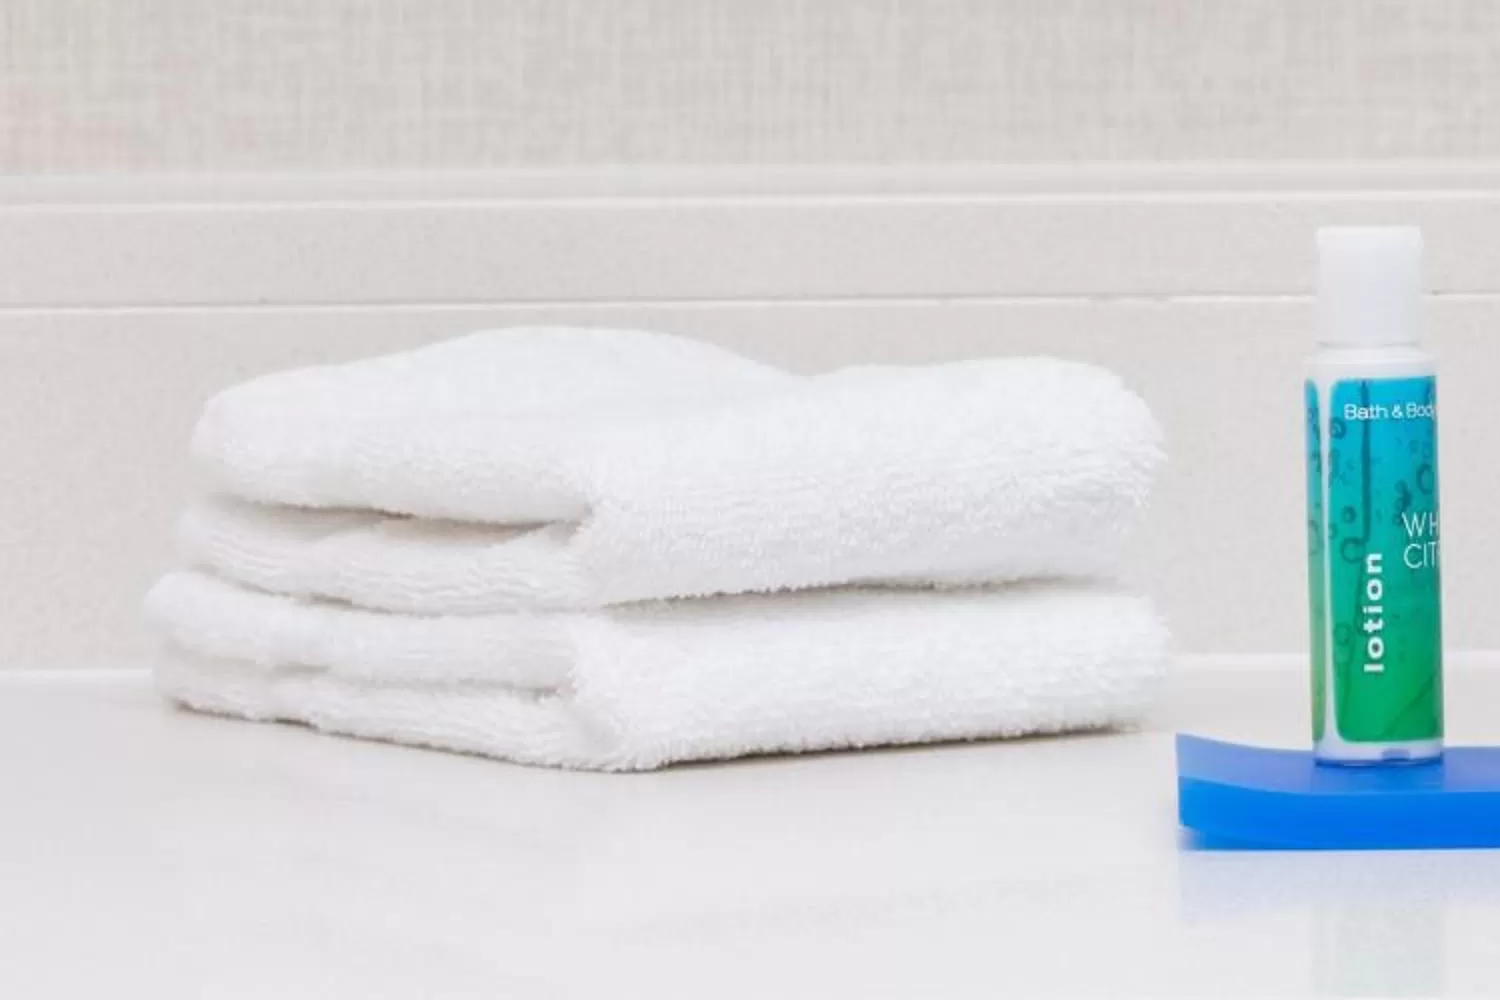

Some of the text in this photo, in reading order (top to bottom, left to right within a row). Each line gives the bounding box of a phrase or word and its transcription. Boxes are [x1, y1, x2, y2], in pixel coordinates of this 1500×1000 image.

[1343, 403, 1389, 420] Bath
[1391, 403, 1403, 419] &
[1362, 552, 1385, 672] lotion
